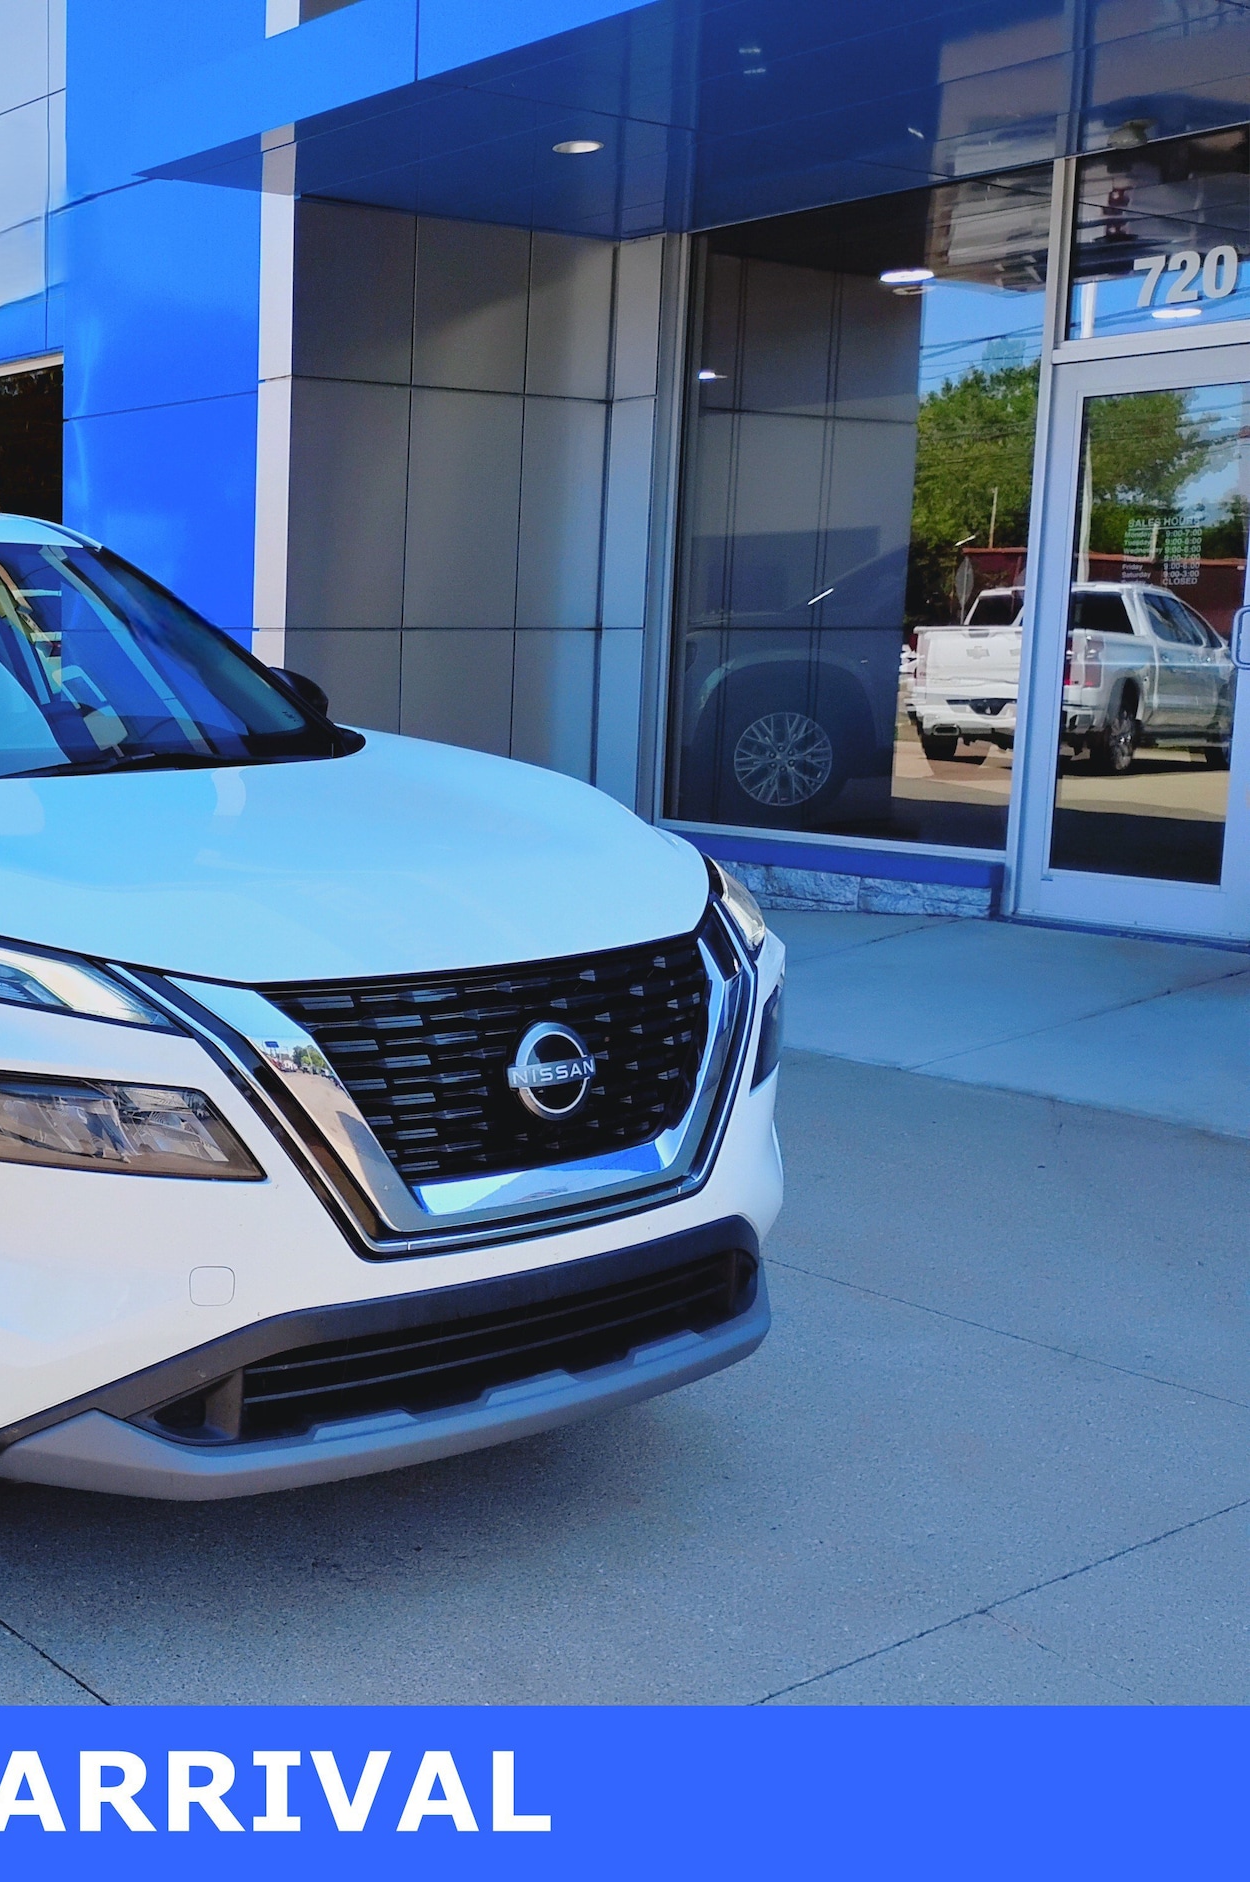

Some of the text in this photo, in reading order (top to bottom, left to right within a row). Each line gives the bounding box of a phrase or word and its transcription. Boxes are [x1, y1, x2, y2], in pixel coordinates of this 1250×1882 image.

[1133, 245, 1238, 308] 720
[1128, 516, 1200, 528] SALES HOURS
[1166, 529, 1203, 537] 9:00-7:00
[1122, 563, 1144, 571] Friday
[1162, 570, 1200, 578] 9:00-3:00
[1162, 577, 1198, 586] CLOSED
[512, 1058, 595, 1085] NISSAN
